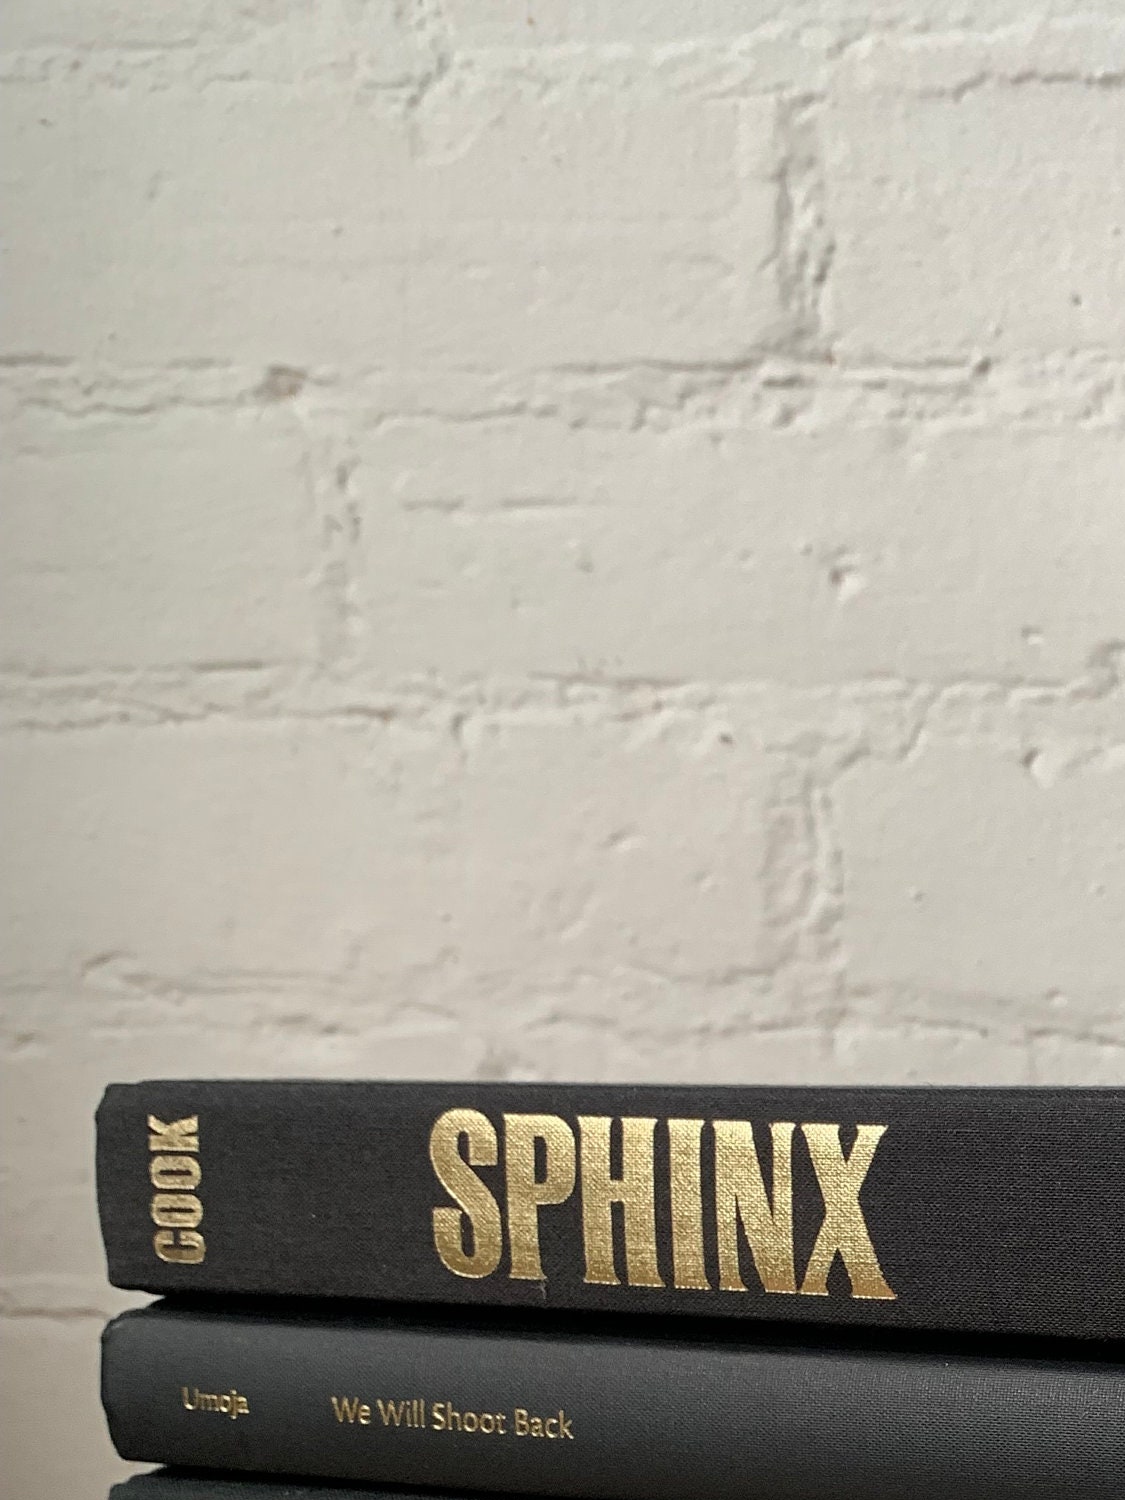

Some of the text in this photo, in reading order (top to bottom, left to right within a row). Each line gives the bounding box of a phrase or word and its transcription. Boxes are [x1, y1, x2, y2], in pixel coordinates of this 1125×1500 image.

[147, 1115, 207, 1264] COOK
[428, 1107, 897, 1301] SPHINX
[181, 1387, 250, 1419] Umoja
[332, 1398, 574, 1440] We Will Shoot Back
